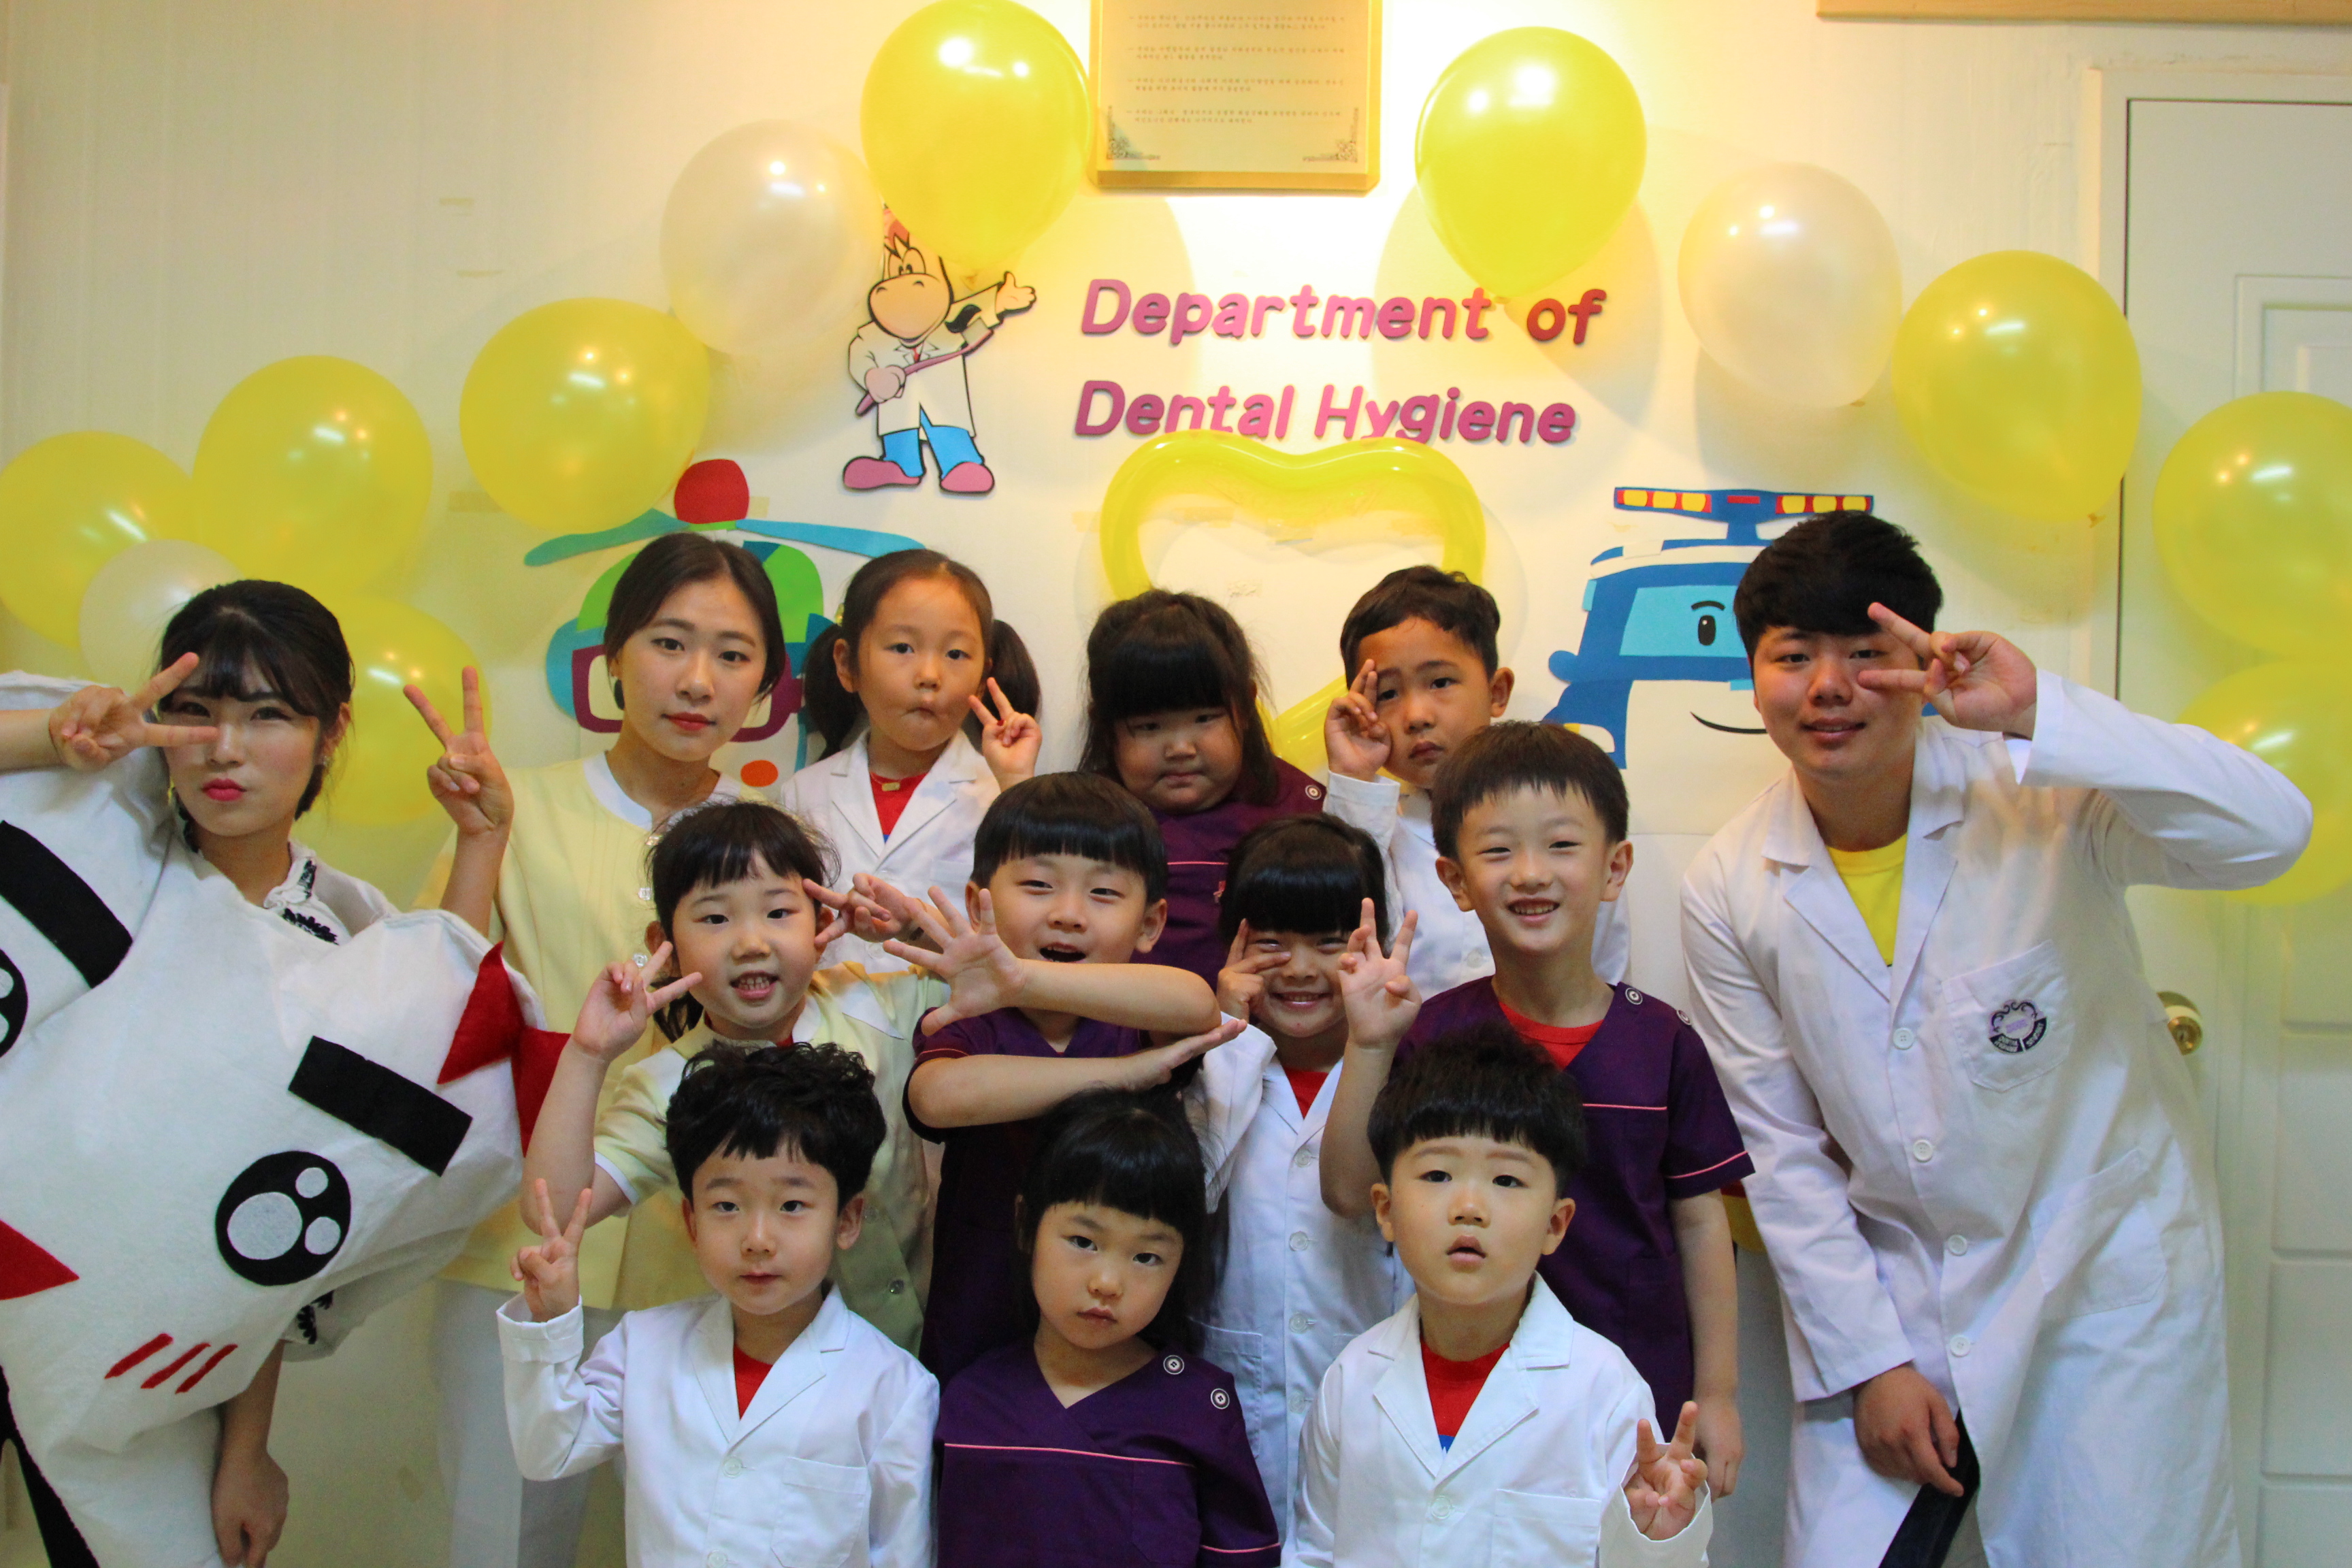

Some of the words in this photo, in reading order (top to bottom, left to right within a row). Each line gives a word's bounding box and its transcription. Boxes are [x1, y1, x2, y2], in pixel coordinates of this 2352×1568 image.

[1081, 278, 1491, 345] Department
[1526, 289, 1607, 345] of
[1075, 380, 1295, 439] Dental
[1313, 384, 1576, 444] Hygiene
